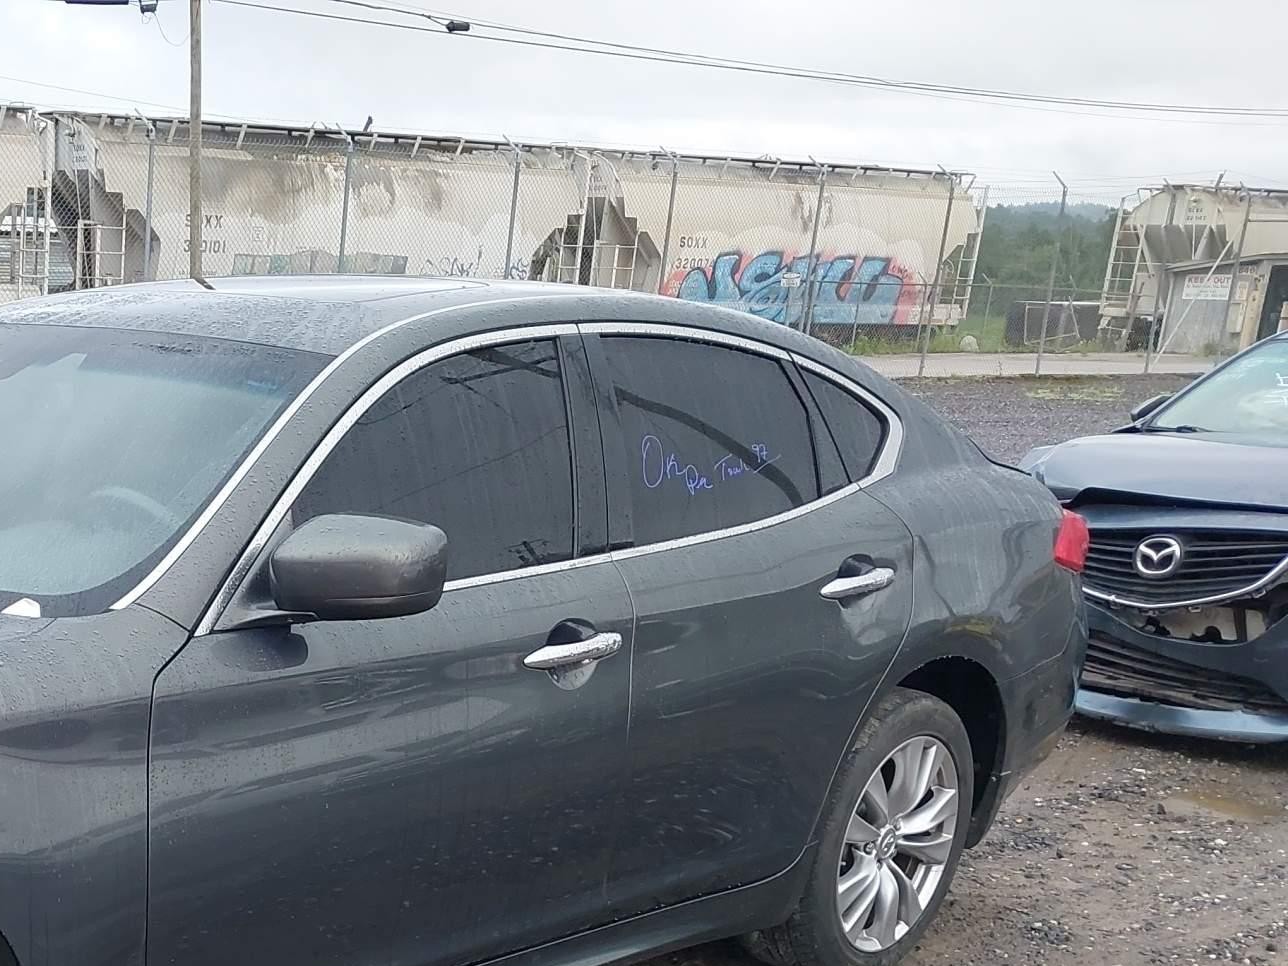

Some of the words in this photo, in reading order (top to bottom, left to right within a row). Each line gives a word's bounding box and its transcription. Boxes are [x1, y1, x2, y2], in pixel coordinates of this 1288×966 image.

[185, 213, 223, 229] SXX
[183, 239, 226, 253] 30101
[679, 236, 708, 249] SOXX
